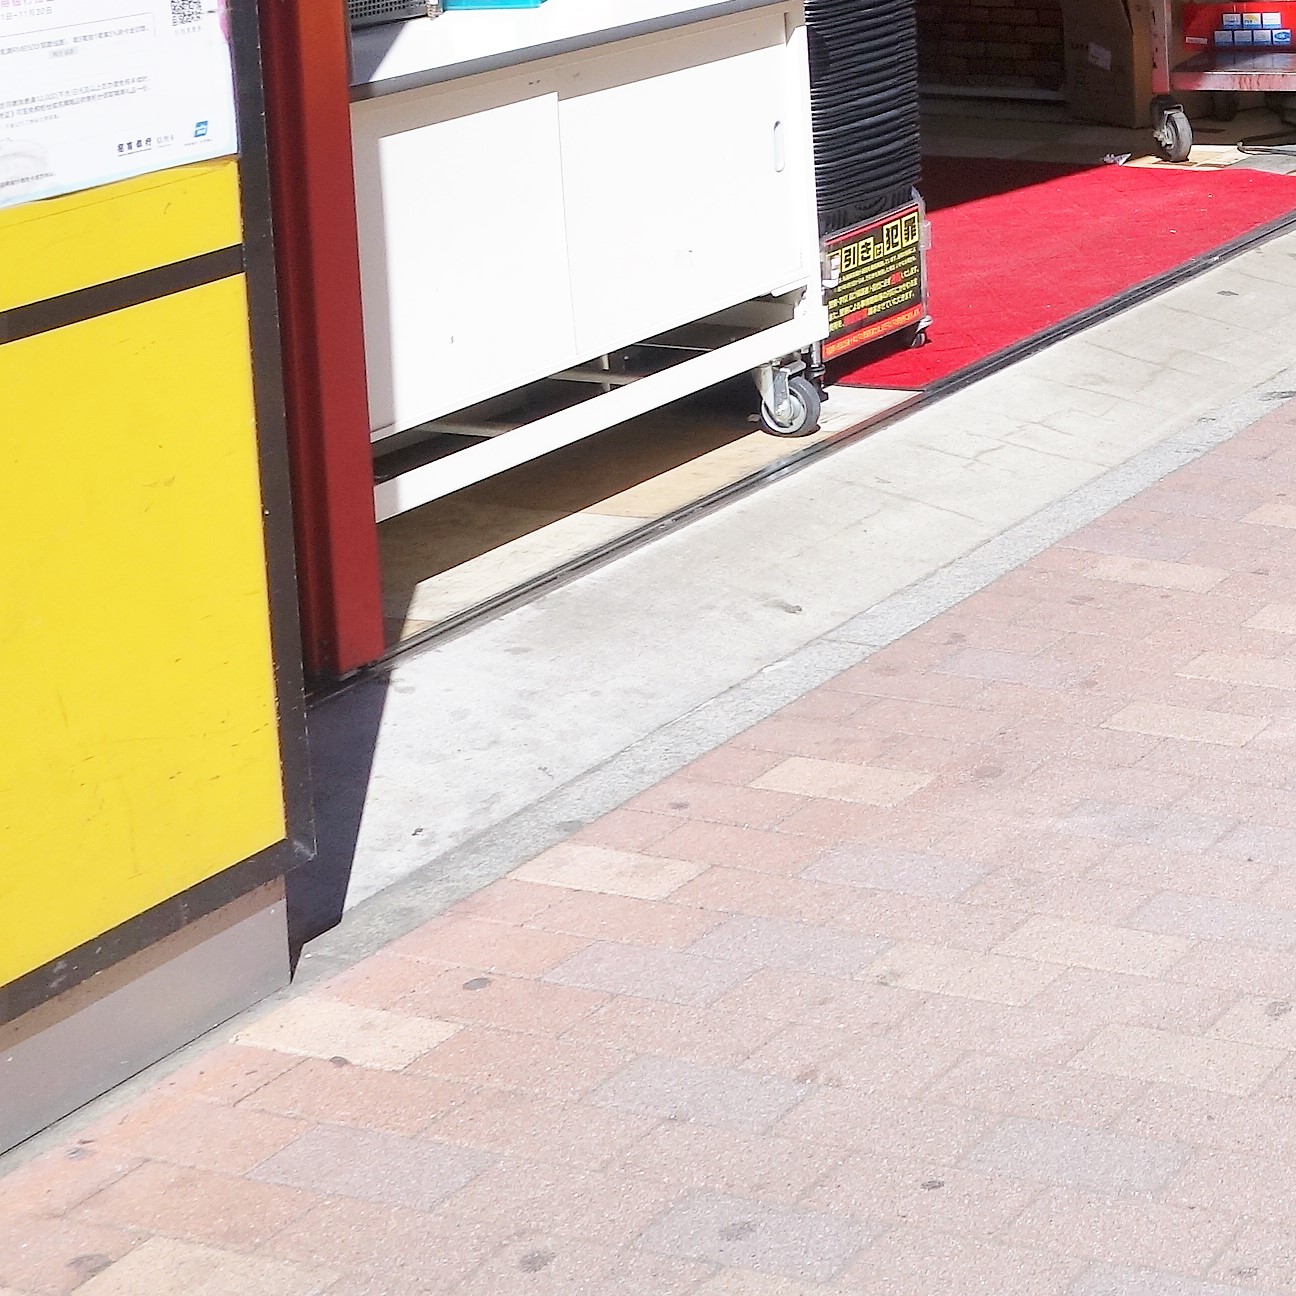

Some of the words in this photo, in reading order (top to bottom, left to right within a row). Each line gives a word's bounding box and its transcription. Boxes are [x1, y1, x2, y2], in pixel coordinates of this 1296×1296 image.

[828, 212, 919, 273] 引きは犯罪
